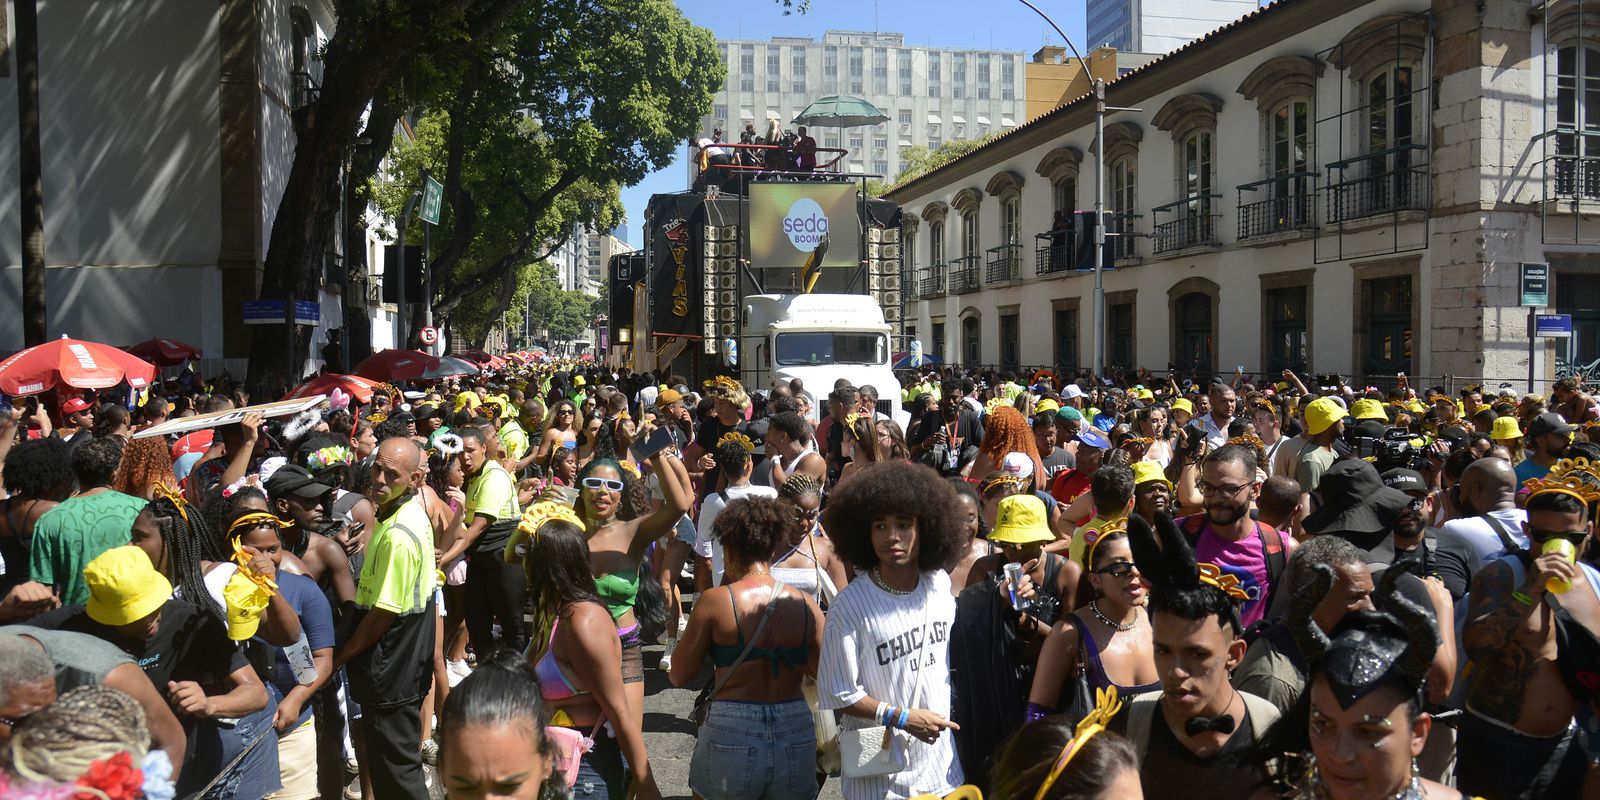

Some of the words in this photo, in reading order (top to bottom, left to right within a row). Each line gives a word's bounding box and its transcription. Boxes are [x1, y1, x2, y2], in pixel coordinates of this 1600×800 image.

[662, 218, 679, 233] Trio
[784, 212, 828, 232] seda
[18, 383, 43, 394] BRAHMA
